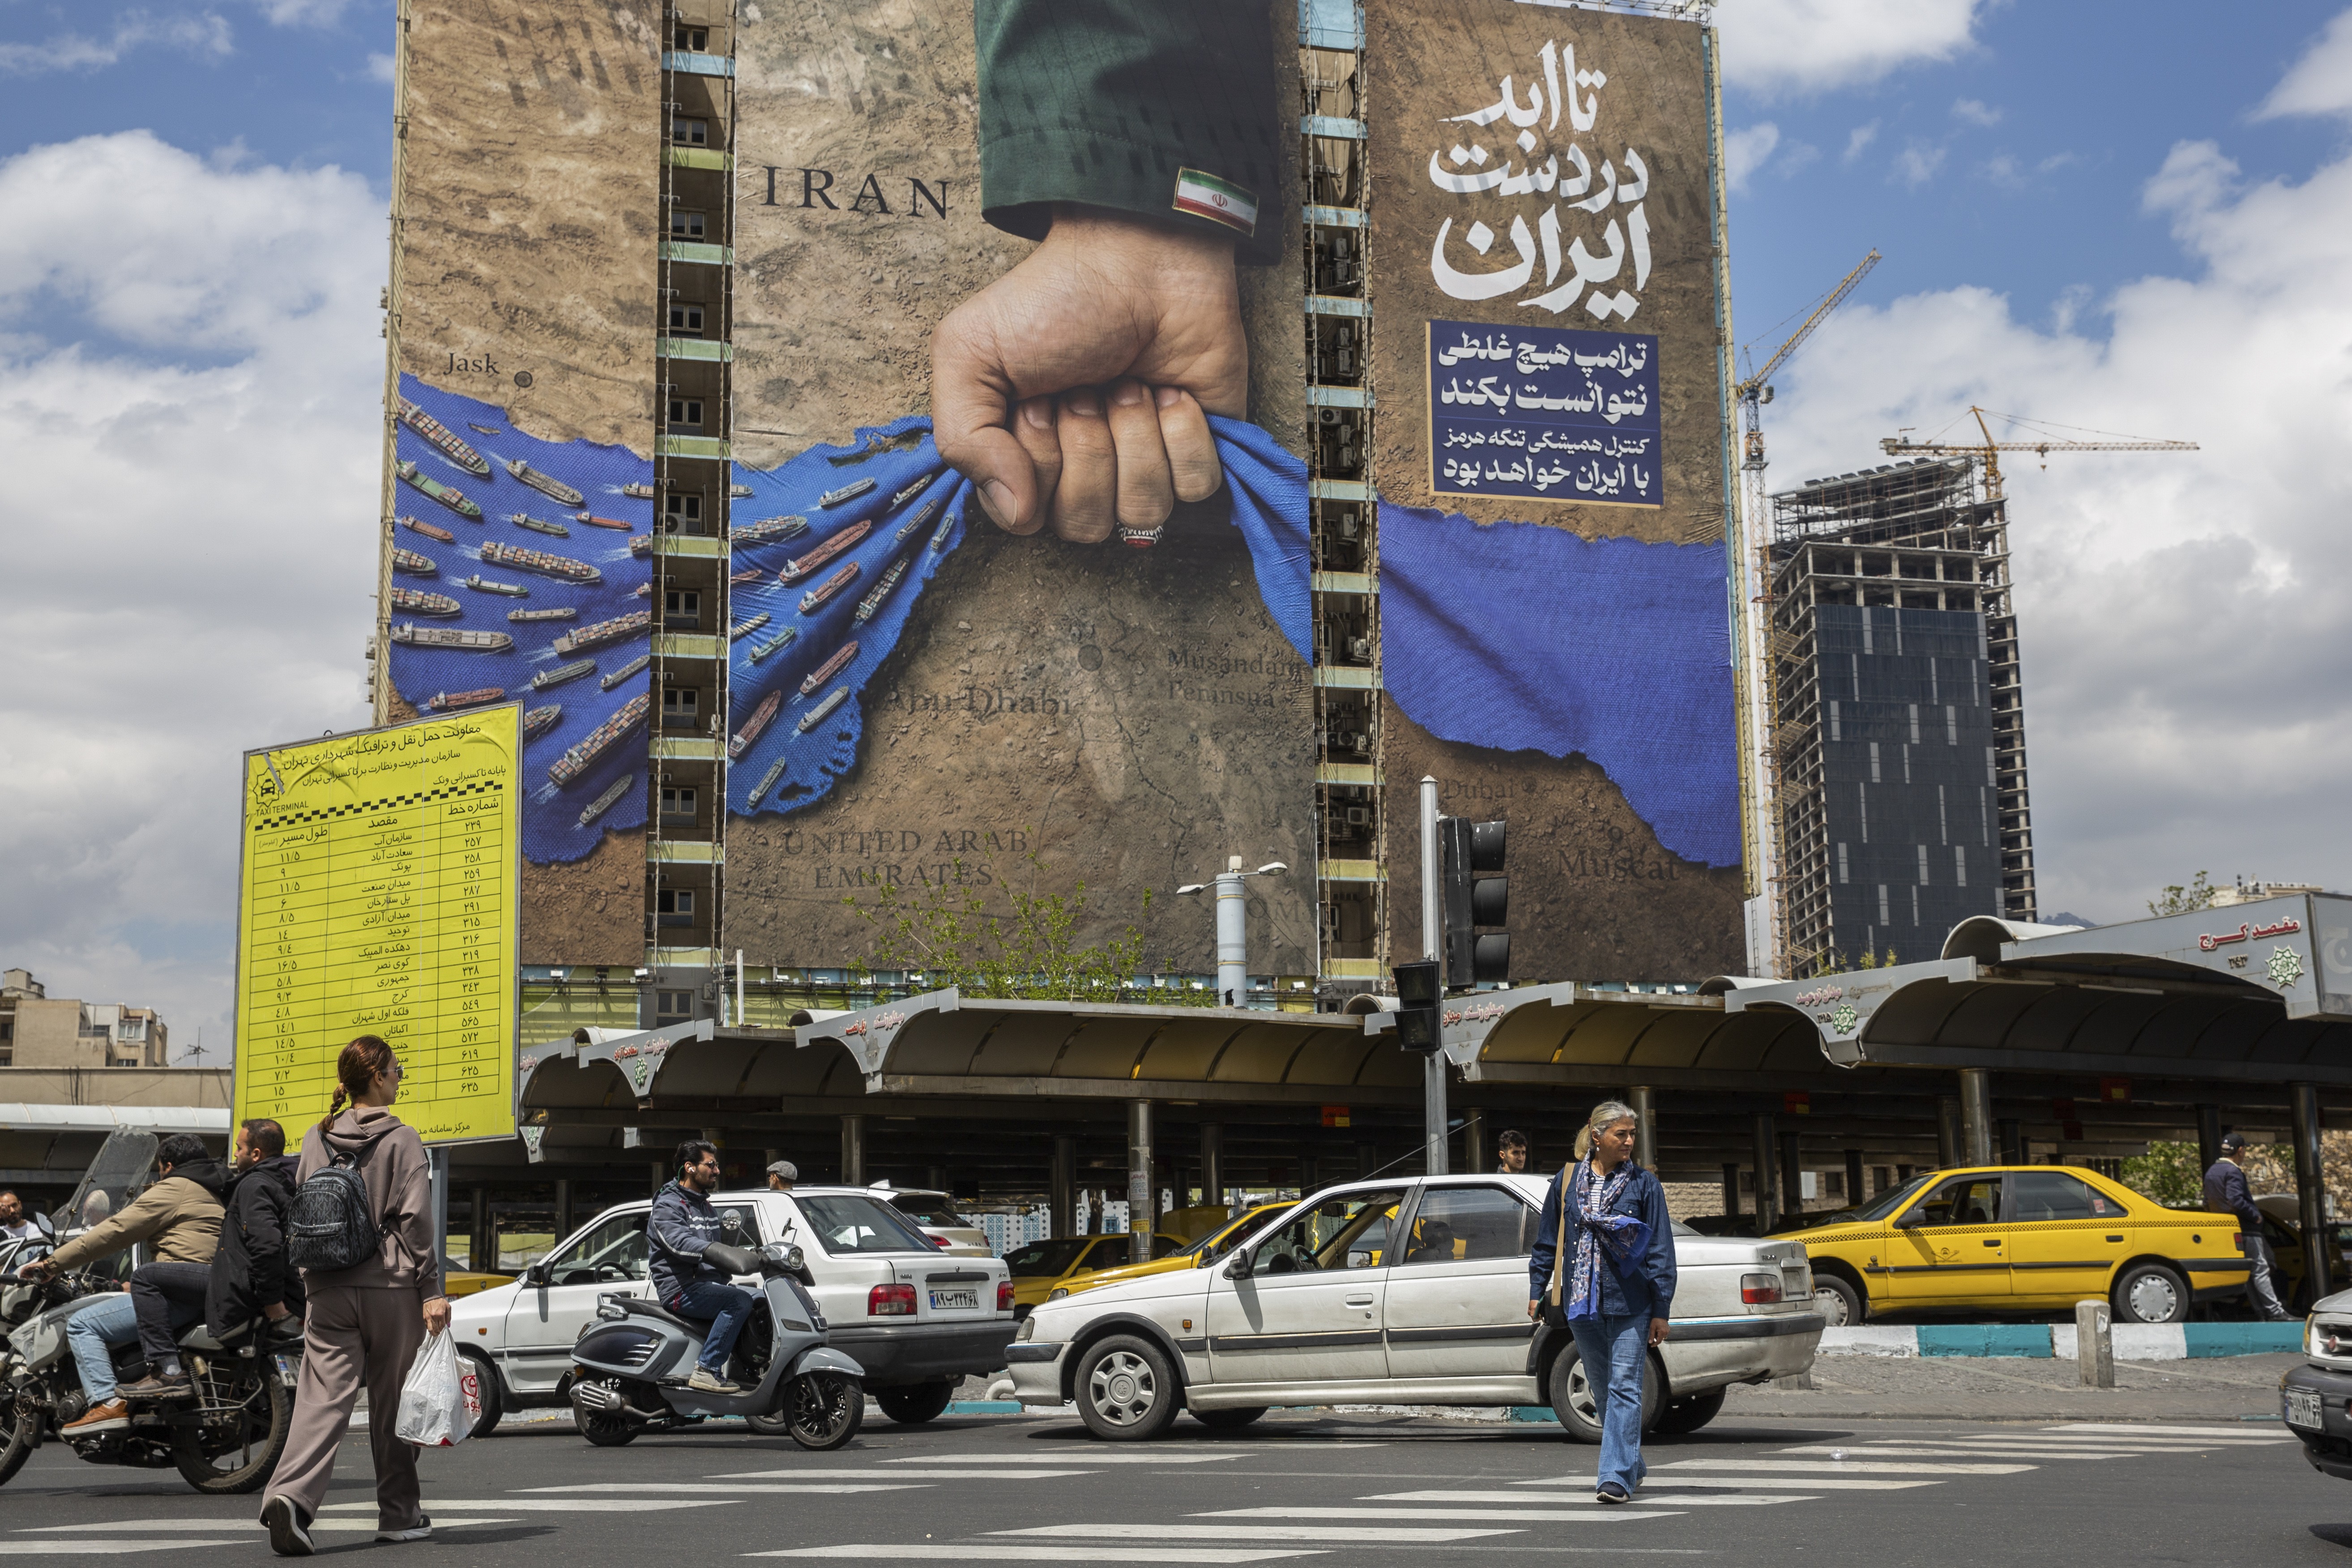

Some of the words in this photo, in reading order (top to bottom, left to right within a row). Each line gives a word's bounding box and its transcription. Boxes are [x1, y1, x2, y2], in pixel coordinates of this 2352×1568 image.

[761, 166, 948, 220] IRAN
[1431, 202, 1651, 322] ایران
[1439, 330, 1513, 366] غلطی
[443, 353, 500, 375] Jask
[1516, 342, 1571, 374] هیچ
[1574, 342, 1647, 378] ترامپ
[1441, 376, 1511, 415] بکند
[1515, 381, 1648, 425] نتوانست
[1443, 428, 1485, 449] هرمز
[1488, 428, 1526, 447] تنگه
[1528, 431, 1602, 454] همیشگی
[1605, 436, 1650, 457] کنترل
[1443, 458, 1480, 487] بود
[1485, 454, 1571, 491] خواهد
[1575, 459, 1626, 495] ایران
[1633, 463, 1649, 496] با
[965, 686, 1071, 718] Dhabi
[444, 724, 481, 739] معاونت
[398, 735, 415, 750] نقل
[418, 731, 440, 747] حمل
[356, 739, 388, 755] ترافیک
[390, 742, 396, 752] و
[311, 746, 354, 765] شهرداری
[431, 750, 460, 763] سازمان
[283, 756, 308, 770] تهران
[399, 757, 429, 769] مدیریت
[357, 768, 367, 778] بر
[451, 769, 487, 784] تاکسیرانی
[488, 765, 506, 776] پایانه
[303, 775, 322, 786] تهران
[433, 775, 449, 786] ونک
[1443, 777, 1514, 800] Dubai
[256, 806, 271, 816] TAXI
[273, 801, 309, 813] TERMINAL
[448, 804, 466, 815] خط
[468, 797, 499, 814] شماره
[368, 816, 397, 828] مقصد
[465, 820, 481, 832] ۲۳۹
[306, 825, 327, 842] طول
[386, 832, 412, 845] سازمان
[279, 834, 304, 847] مسیر
[374, 834, 385, 847] آب
[465, 836, 481, 847] ۲۵۷
[784, 829, 921, 854] UNITED
[935, 830, 1028, 852] ARAB
[371, 849, 385, 862] آباد
[386, 848, 412, 858] سعادت
[465, 852, 481, 863] ۲۵۸
[392, 862, 411, 873] پونک
[1555, 849, 1680, 881] Muscat
[464, 868, 480, 880] ۲۵۹
[815, 863, 993, 889] EMIRATES
[362, 884, 385, 892] صنعت
[388, 880, 410, 890] میدان
[464, 885, 480, 897] ۲۸۷
[367, 895, 398, 909] ستارخان
[401, 893, 410, 905] پل
[464, 901, 479, 913] ۲۹۱
[363, 911, 385, 926] آزادی
[388, 911, 410, 922] میدان
[463, 917, 480, 928] ۳۱۵
[388, 926, 410, 937] توحید
[2251, 916, 2301, 939] مقصد
[463, 933, 480, 945] ۳۱۶
[2199, 923, 2248, 950] کرج
[359, 946, 382, 959] المپیک
[385, 943, 410, 953] دهکده
[463, 949, 479, 961] ۳۱۹
[375, 961, 391, 974] نصر
[393, 957, 410, 970] کوی
[462, 965, 479, 977] ۳۳۸
[377, 975, 409, 987] جمهوری
[392, 989, 409, 1004] کرج
[1796, 987, 1822, 1006] توحید
[1822, 984, 1842, 1003] میدان
[377, 1008, 390, 1021] اول
[393, 1007, 409, 1016] فلکه
[1484, 1002, 1504, 1020] میدان
[1817, 1012, 1832, 1023] ۳۱۵
[352, 1011, 375, 1025] شهران
[461, 1017, 479, 1027] ۵۶۵
[888, 1010, 904, 1028] میدان
[384, 1024, 408, 1037] اکباتان
[461, 1031, 478, 1043] ۵۷۲
[462, 1049, 478, 1060] ۶۱۹
[461, 1066, 478, 1077] ۶۲۵
[461, 1082, 478, 1093] ۶۳۵
[429, 1124, 452, 1133] سامانه
[453, 1122, 470, 1134] مرکز
